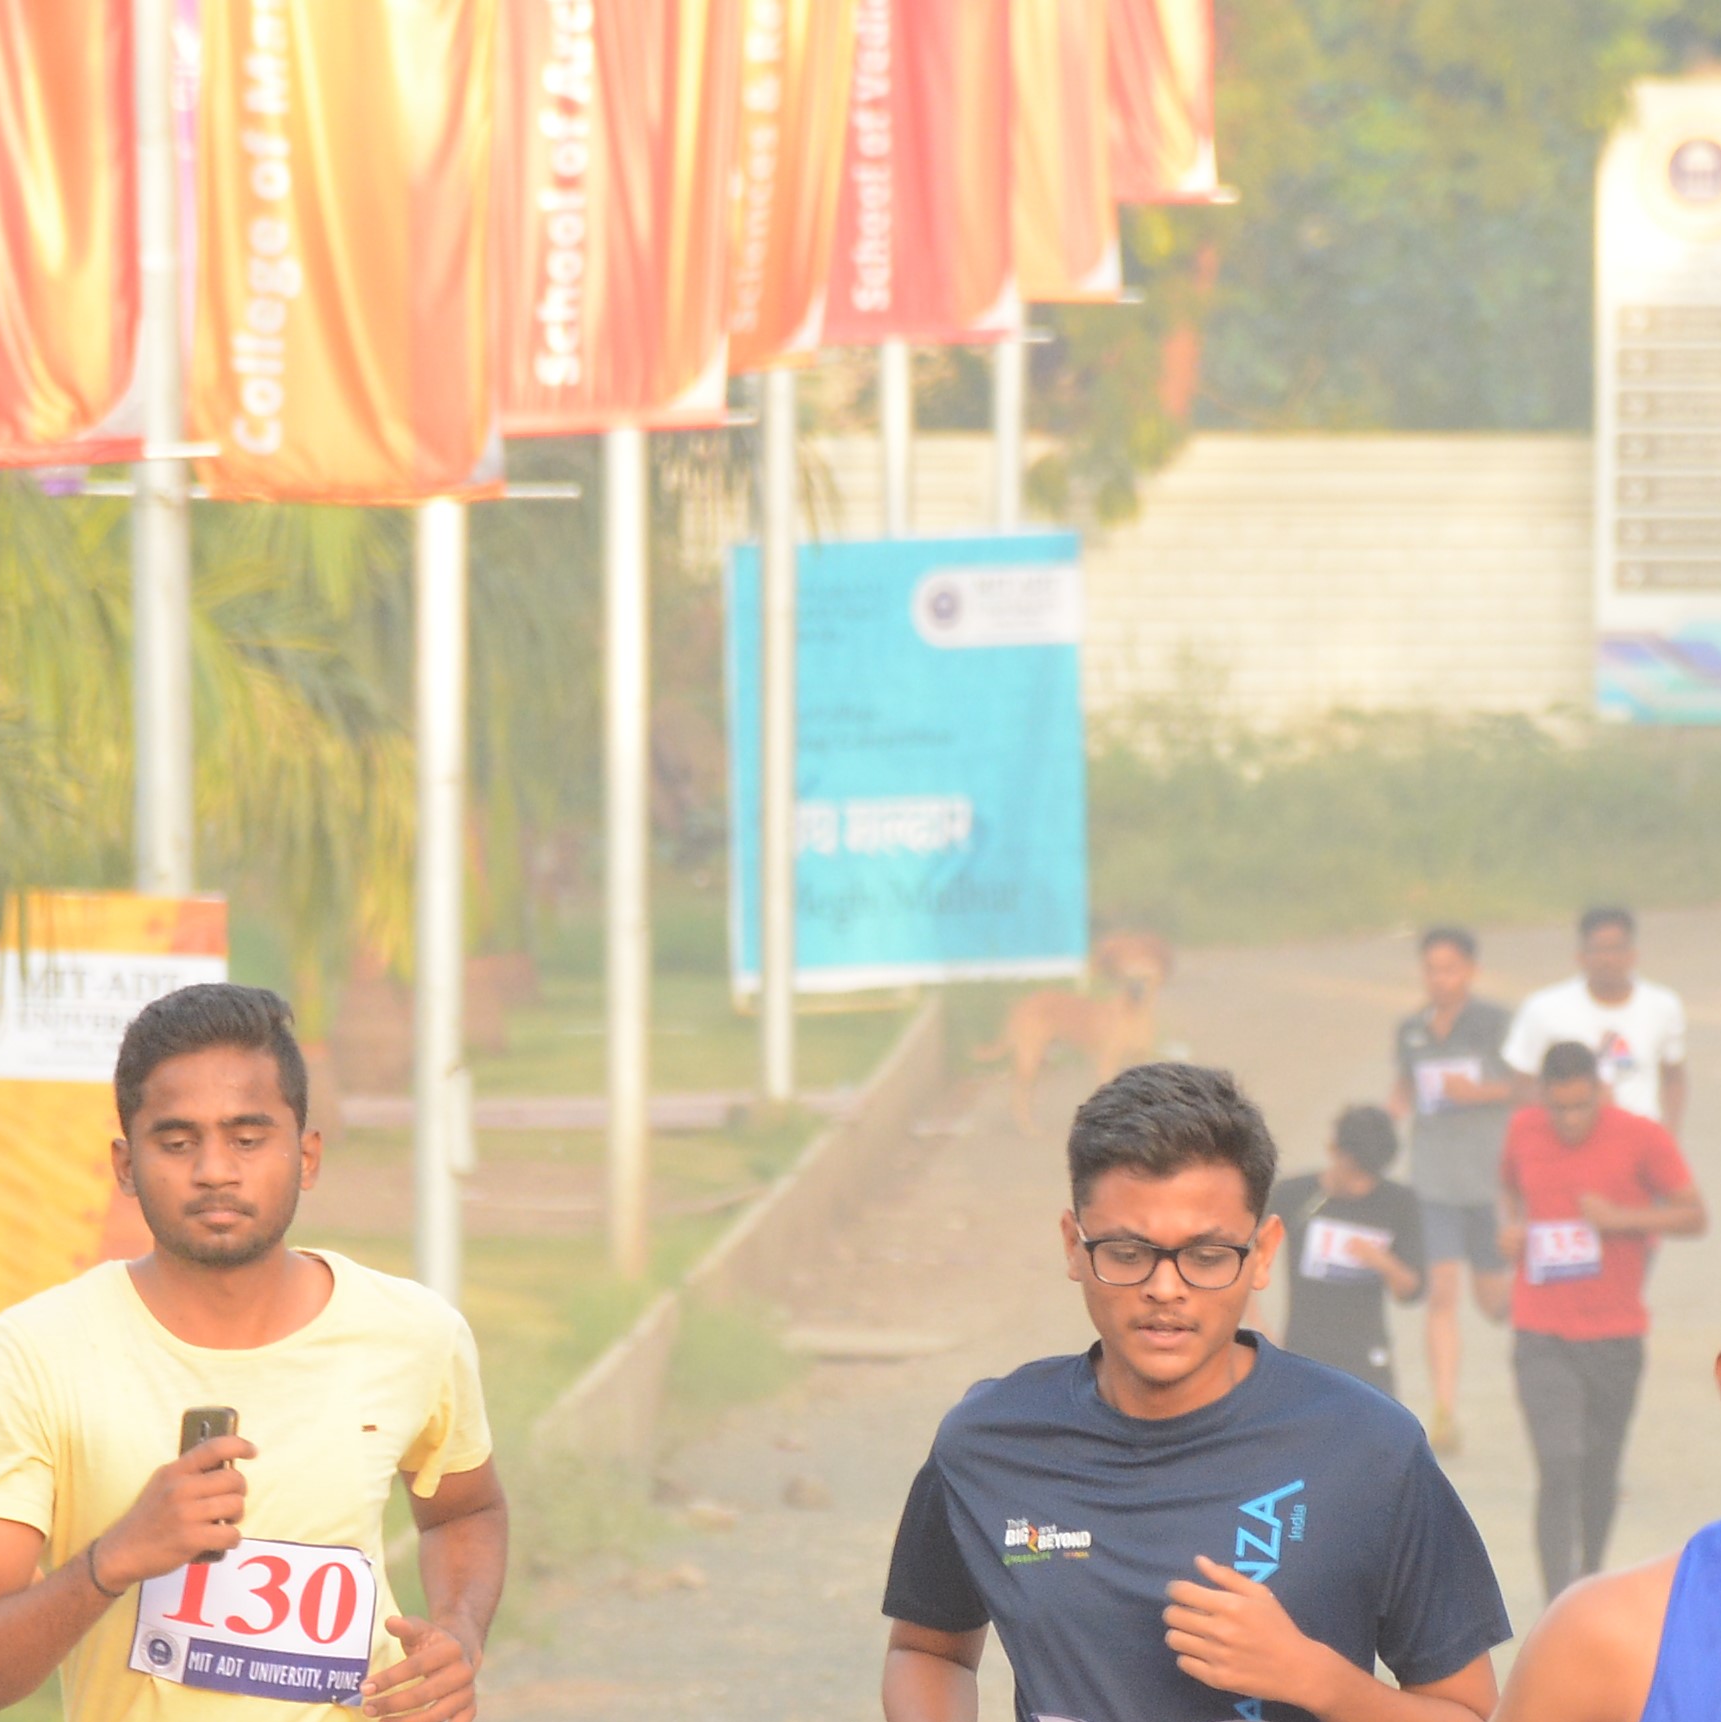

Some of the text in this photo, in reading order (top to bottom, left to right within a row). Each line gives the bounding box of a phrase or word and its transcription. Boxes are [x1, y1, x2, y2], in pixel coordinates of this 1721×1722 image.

[241, 129, 292, 200] of
[538, 108, 589, 176] of
[532, 187, 583, 387] School
[231, 216, 303, 456] College
[1005, 1527, 1092, 1552] BIG BEYOND
[162, 1554, 358, 1645] 130
[187, 1651, 362, 1691] MIT ADT UNIVERSITY, PUNE
